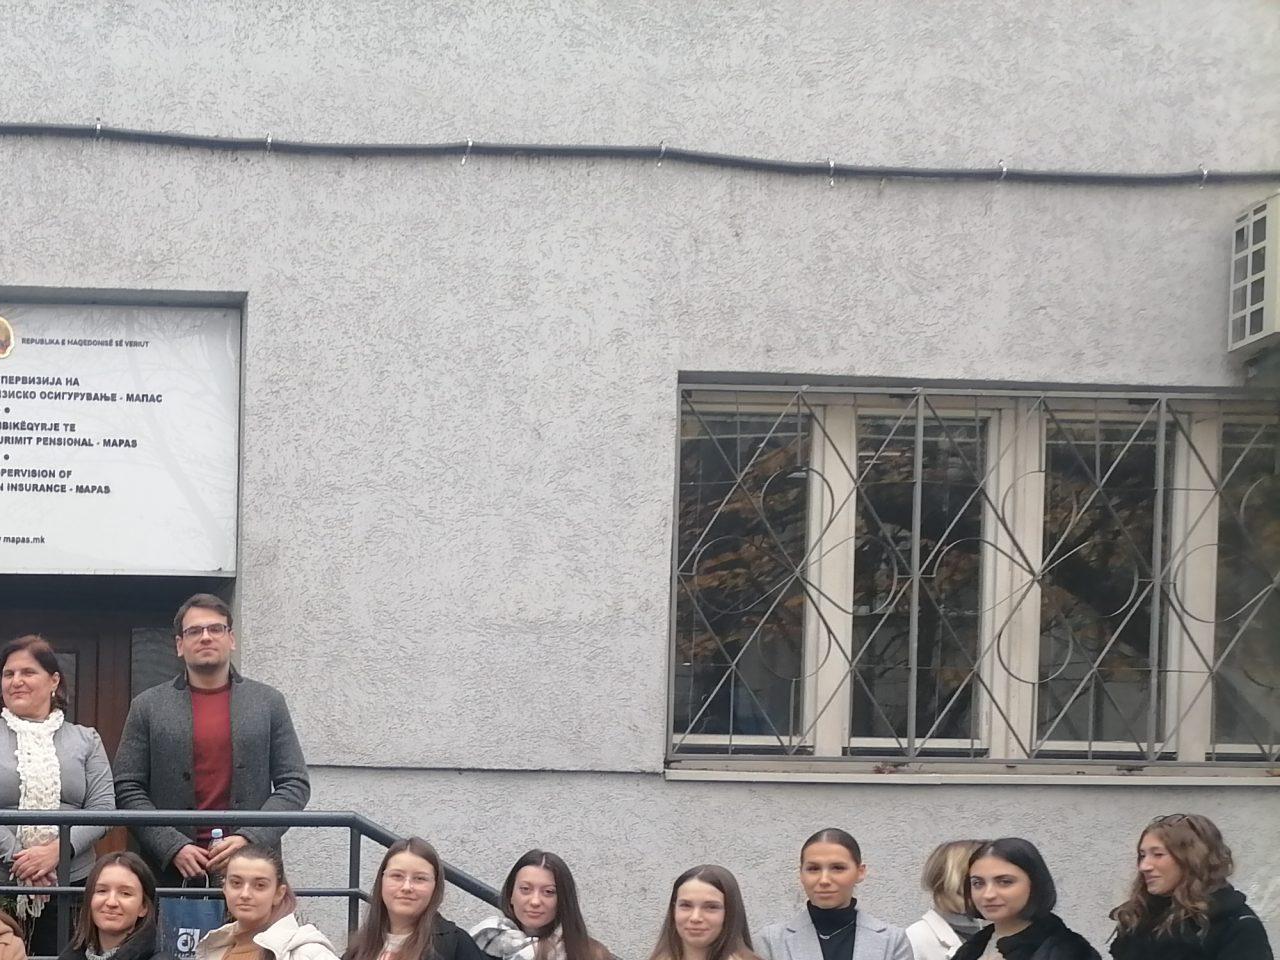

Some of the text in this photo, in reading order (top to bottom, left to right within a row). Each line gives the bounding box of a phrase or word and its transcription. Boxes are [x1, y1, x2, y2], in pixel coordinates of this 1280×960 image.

[22, 337, 60, 346] REPUBLIKA
[125, 340, 150, 348] VERIUT
[65, 377, 80, 386] НА
[40, 390, 117, 402] ОСИГУРУВАЊЕ
[126, 393, 163, 403] МАПАС
[36, 437, 94, 447] PENSIONAL
[103, 438, 138, 448] MAPAS
[59, 470, 72, 478] OF
[7, 483, 67, 493] INSURANCE
[75, 485, 111, 494] MAPAS
